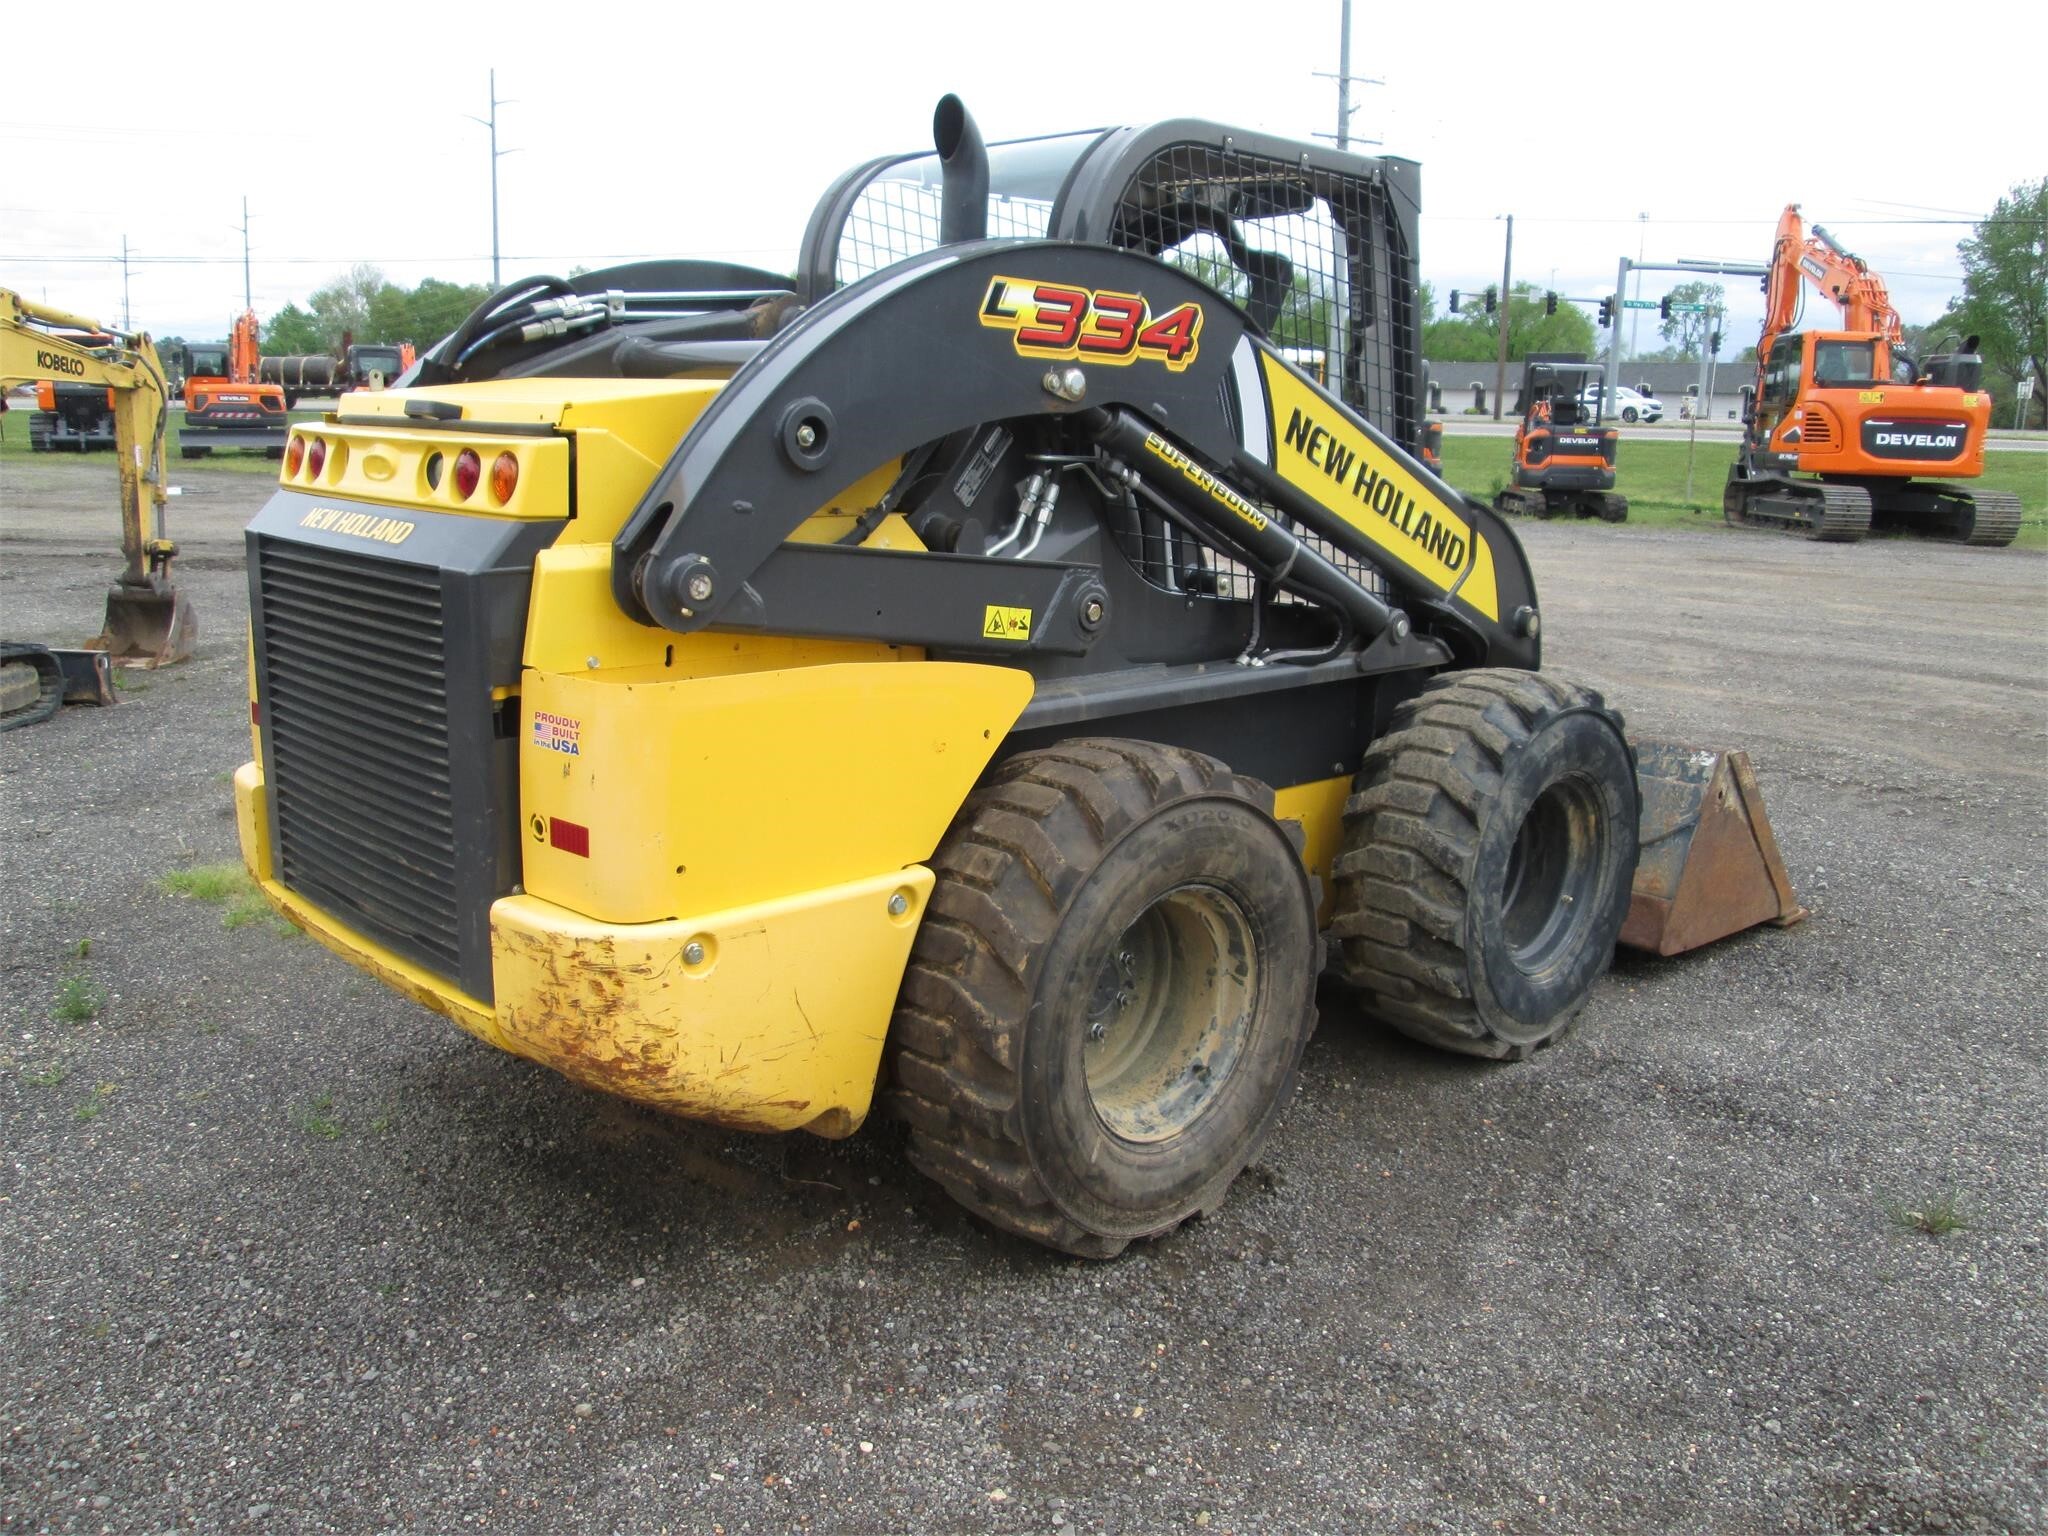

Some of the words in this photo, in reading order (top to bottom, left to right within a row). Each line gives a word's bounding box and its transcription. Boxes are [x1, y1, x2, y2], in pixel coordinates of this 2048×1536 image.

[981, 277, 1202, 368] L334
[37, 350, 85, 377] KOBELCO
[1559, 437, 1599, 445] DEVELON
[1875, 432, 1957, 448] DEVELON
[1145, 432, 1214, 492] SUPER
[1211, 480, 1269, 532] BOOM
[1284, 406, 1355, 485] NEW
[1352, 460, 1466, 572] HOLLAND
[299, 507, 344, 531] NEW
[332, 511, 416, 545] HOLLAND
[534, 711, 581, 730] PROUDLY
[552, 726, 581, 741] BUILT
[540, 740, 551, 749] the
[551, 737, 580, 756] USA
